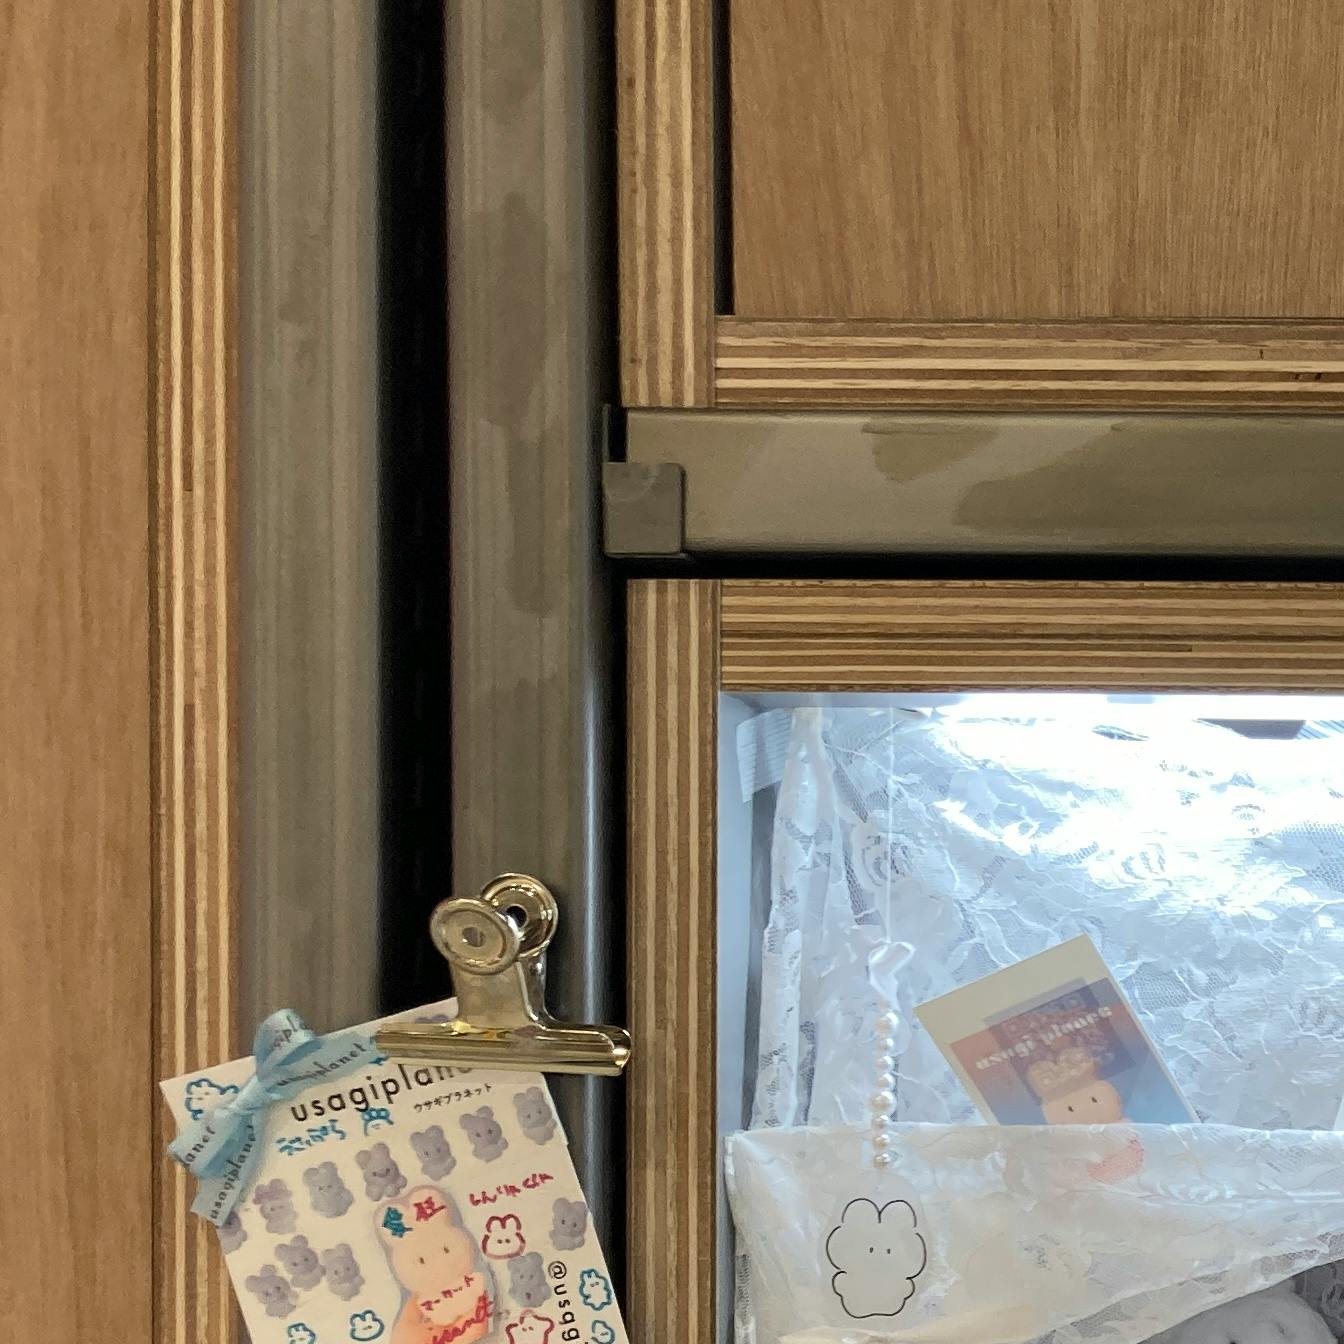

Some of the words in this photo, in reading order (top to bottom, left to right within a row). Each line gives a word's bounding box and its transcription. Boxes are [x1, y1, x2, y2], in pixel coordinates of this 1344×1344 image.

[290, 1062, 474, 1122] usagiplan
[413, 1082, 493, 1113] ウサギプラネット
